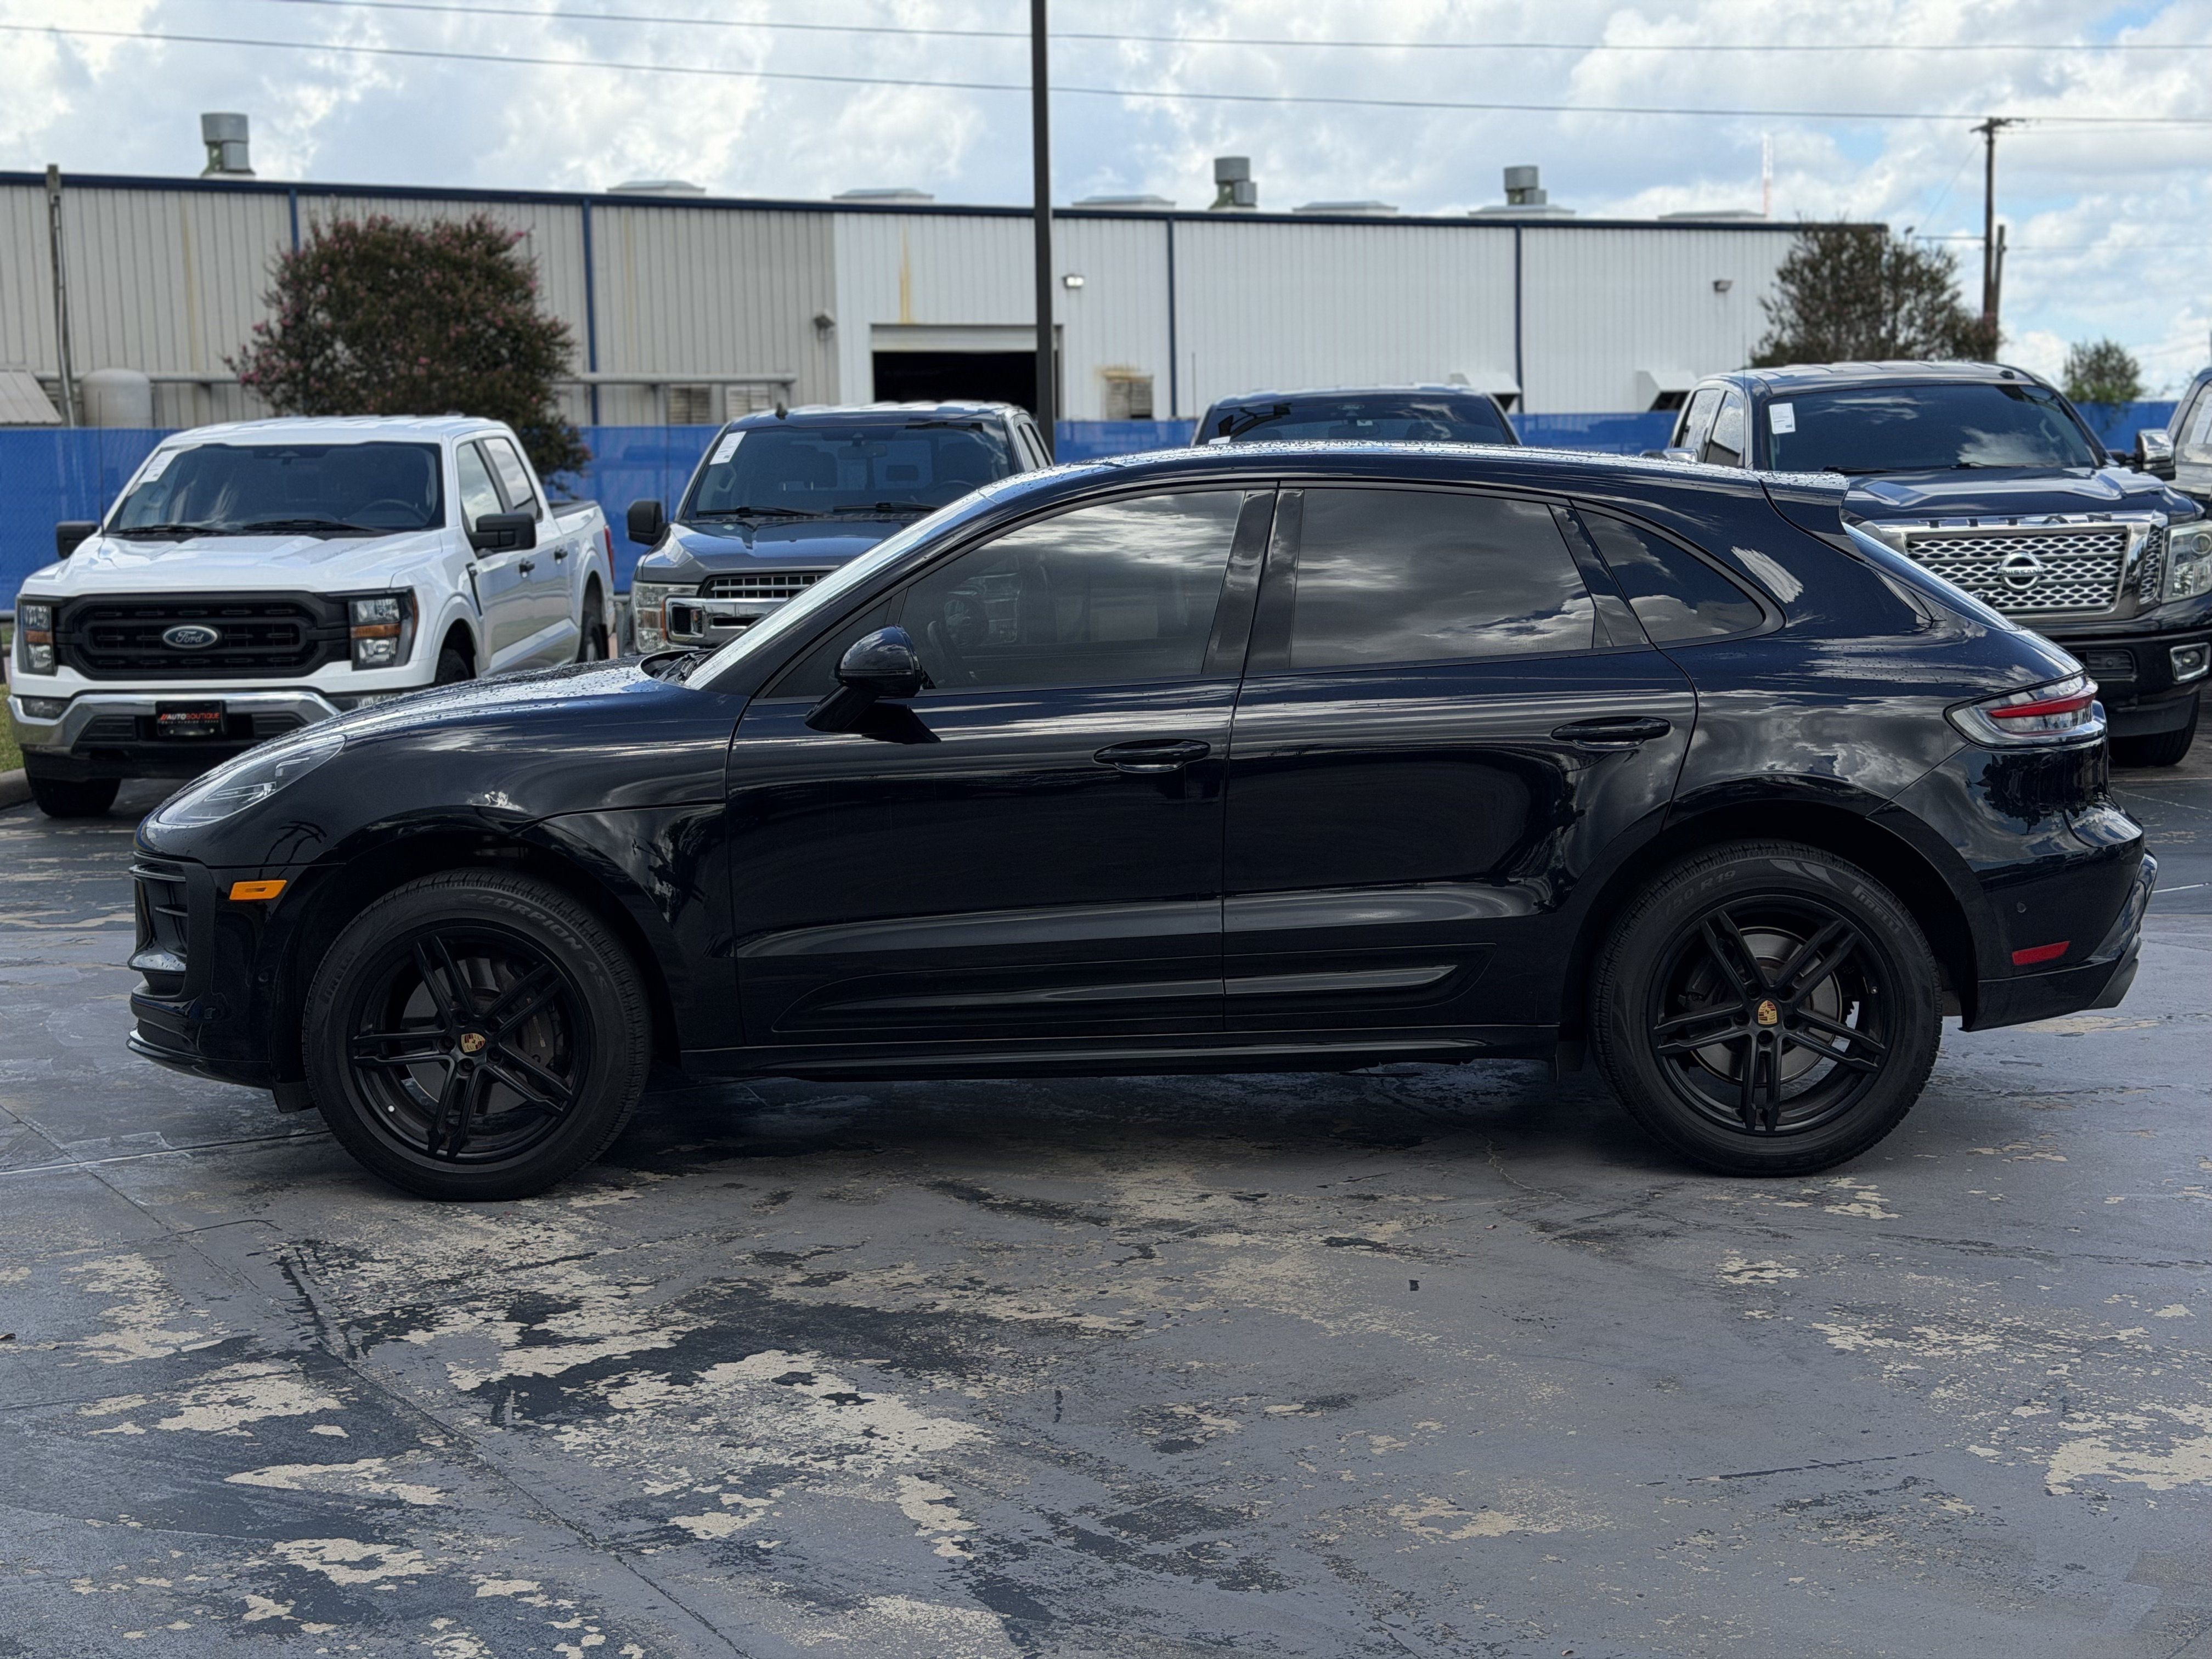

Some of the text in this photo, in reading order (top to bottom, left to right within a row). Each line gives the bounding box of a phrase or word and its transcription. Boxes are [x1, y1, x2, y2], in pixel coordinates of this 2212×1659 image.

[1917, 512, 2113, 528] TITAN
[176, 630, 205, 643] Ford
[1851, 884, 1904, 934] PIRELLI
